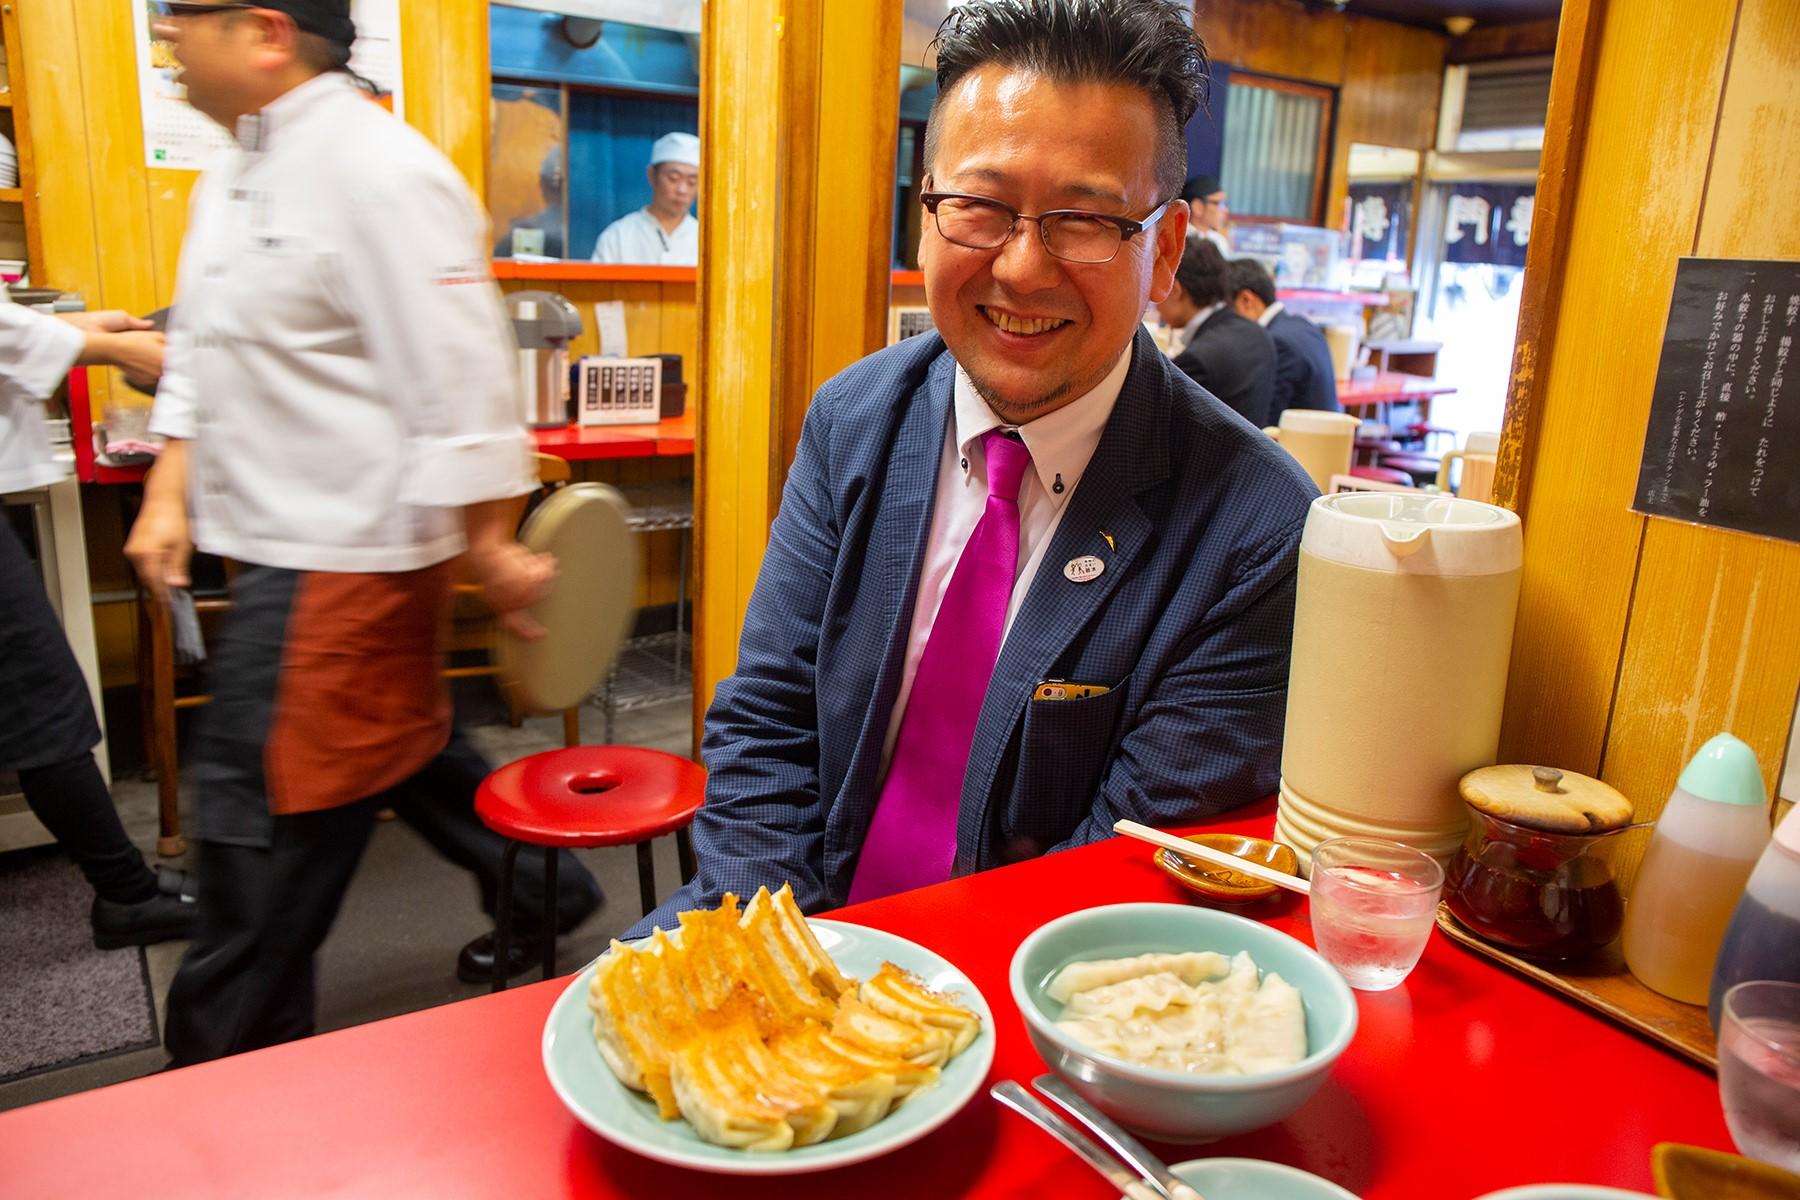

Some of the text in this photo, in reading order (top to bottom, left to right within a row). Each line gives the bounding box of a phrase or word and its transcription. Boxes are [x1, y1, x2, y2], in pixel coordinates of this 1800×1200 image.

[1687, 291, 1729, 462] お好みでかけてお召し上がりください。
[1725, 291, 1752, 377] 水餃子の器の中に、
[1745, 294, 1776, 399] お召し上がりください。
[1719, 382, 1735, 403] 直接
[1749, 437, 1769, 497] たれをつけて
